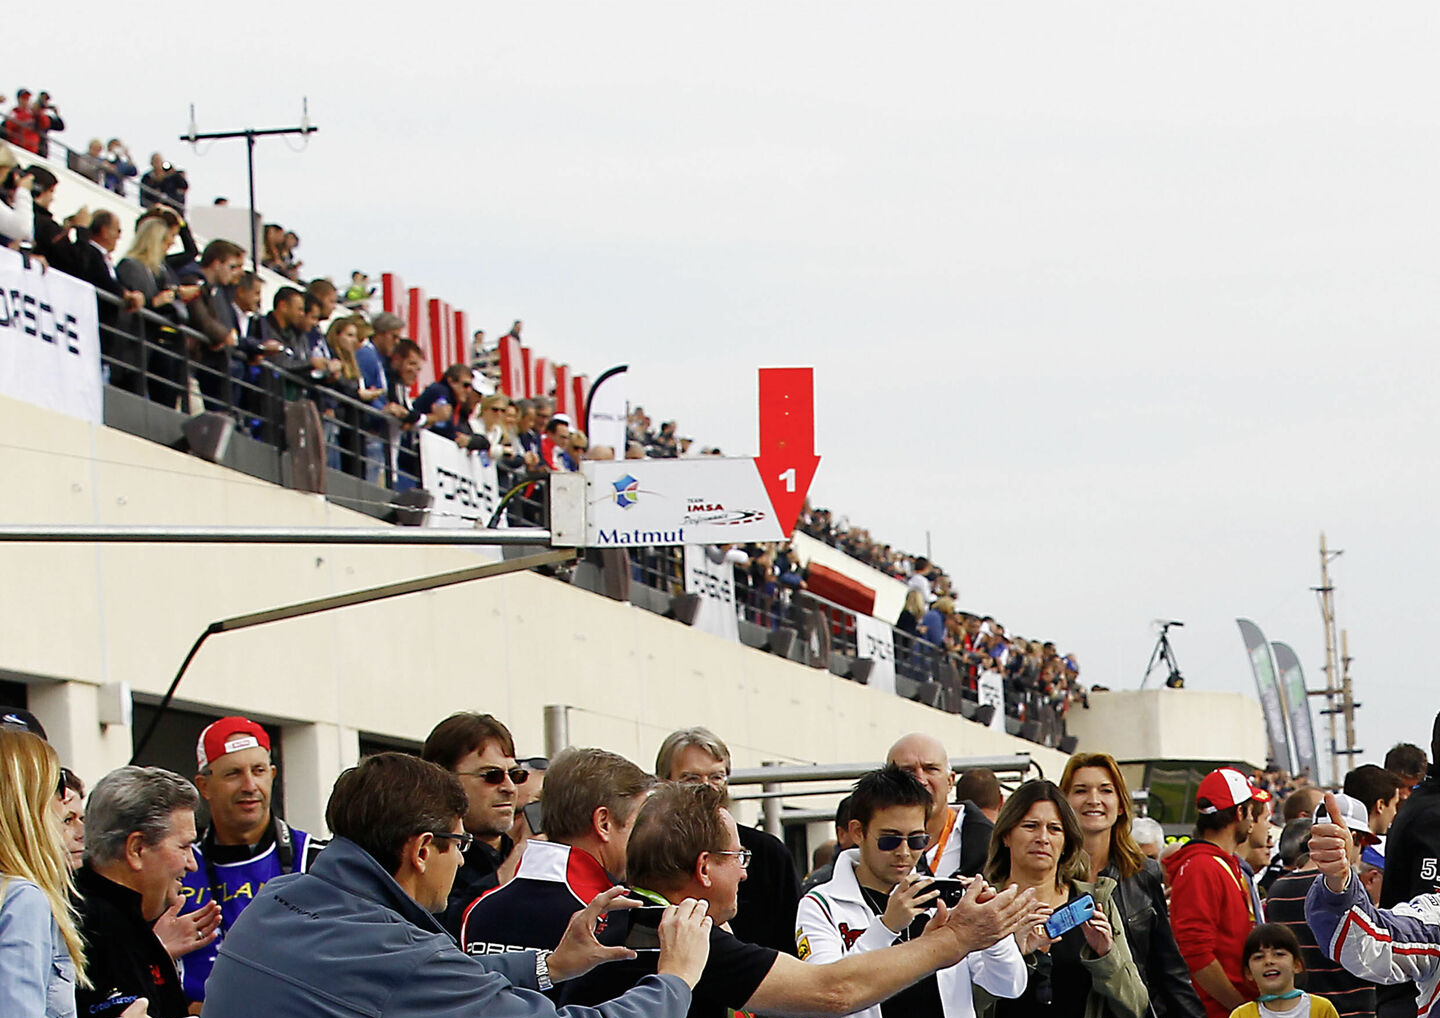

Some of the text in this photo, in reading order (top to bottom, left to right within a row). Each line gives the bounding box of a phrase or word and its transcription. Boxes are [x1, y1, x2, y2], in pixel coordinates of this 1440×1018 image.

[778, 468, 796, 493] 1
[687, 504, 724, 512] IMSA
[597, 528, 685, 544] Matmut
